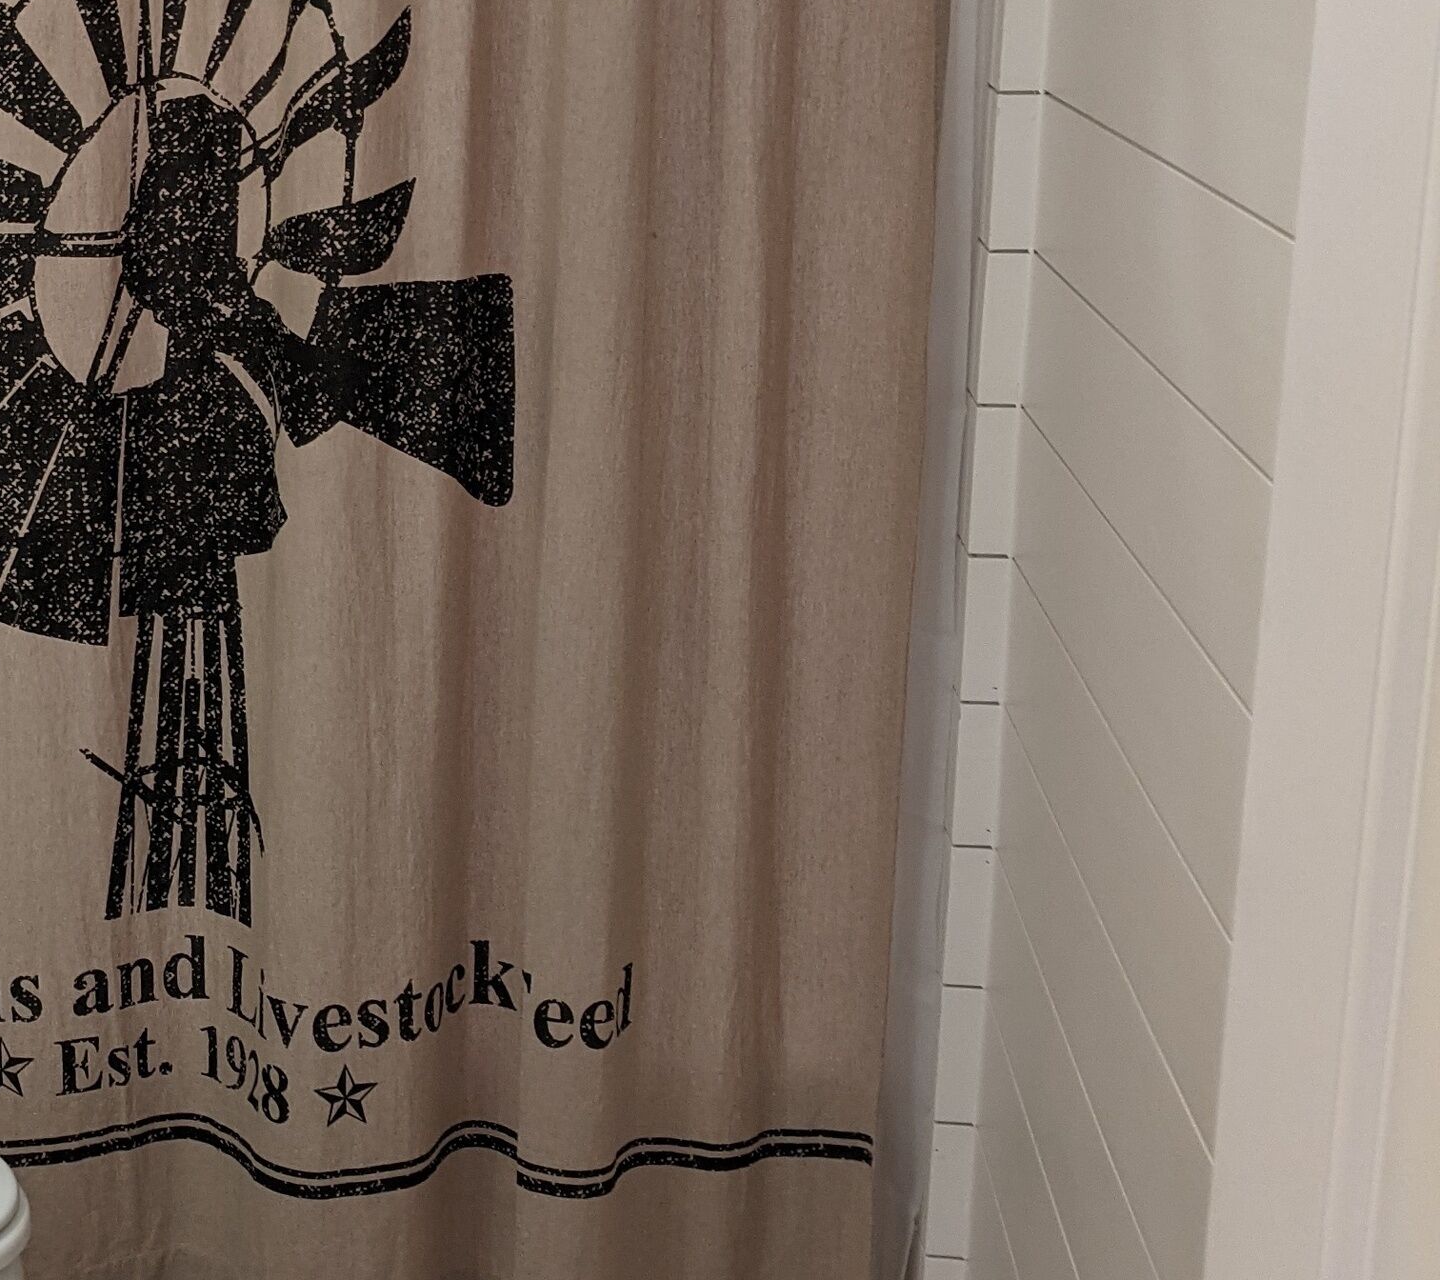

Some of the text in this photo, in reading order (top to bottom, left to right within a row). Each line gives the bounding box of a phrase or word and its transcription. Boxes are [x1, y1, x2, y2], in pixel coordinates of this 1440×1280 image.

[73, 935, 209, 1017] and
[227, 939, 519, 1052] Livestock
[522, 962, 633, 1050] eed
[54, 1026, 289, 1124] Est. 1928
